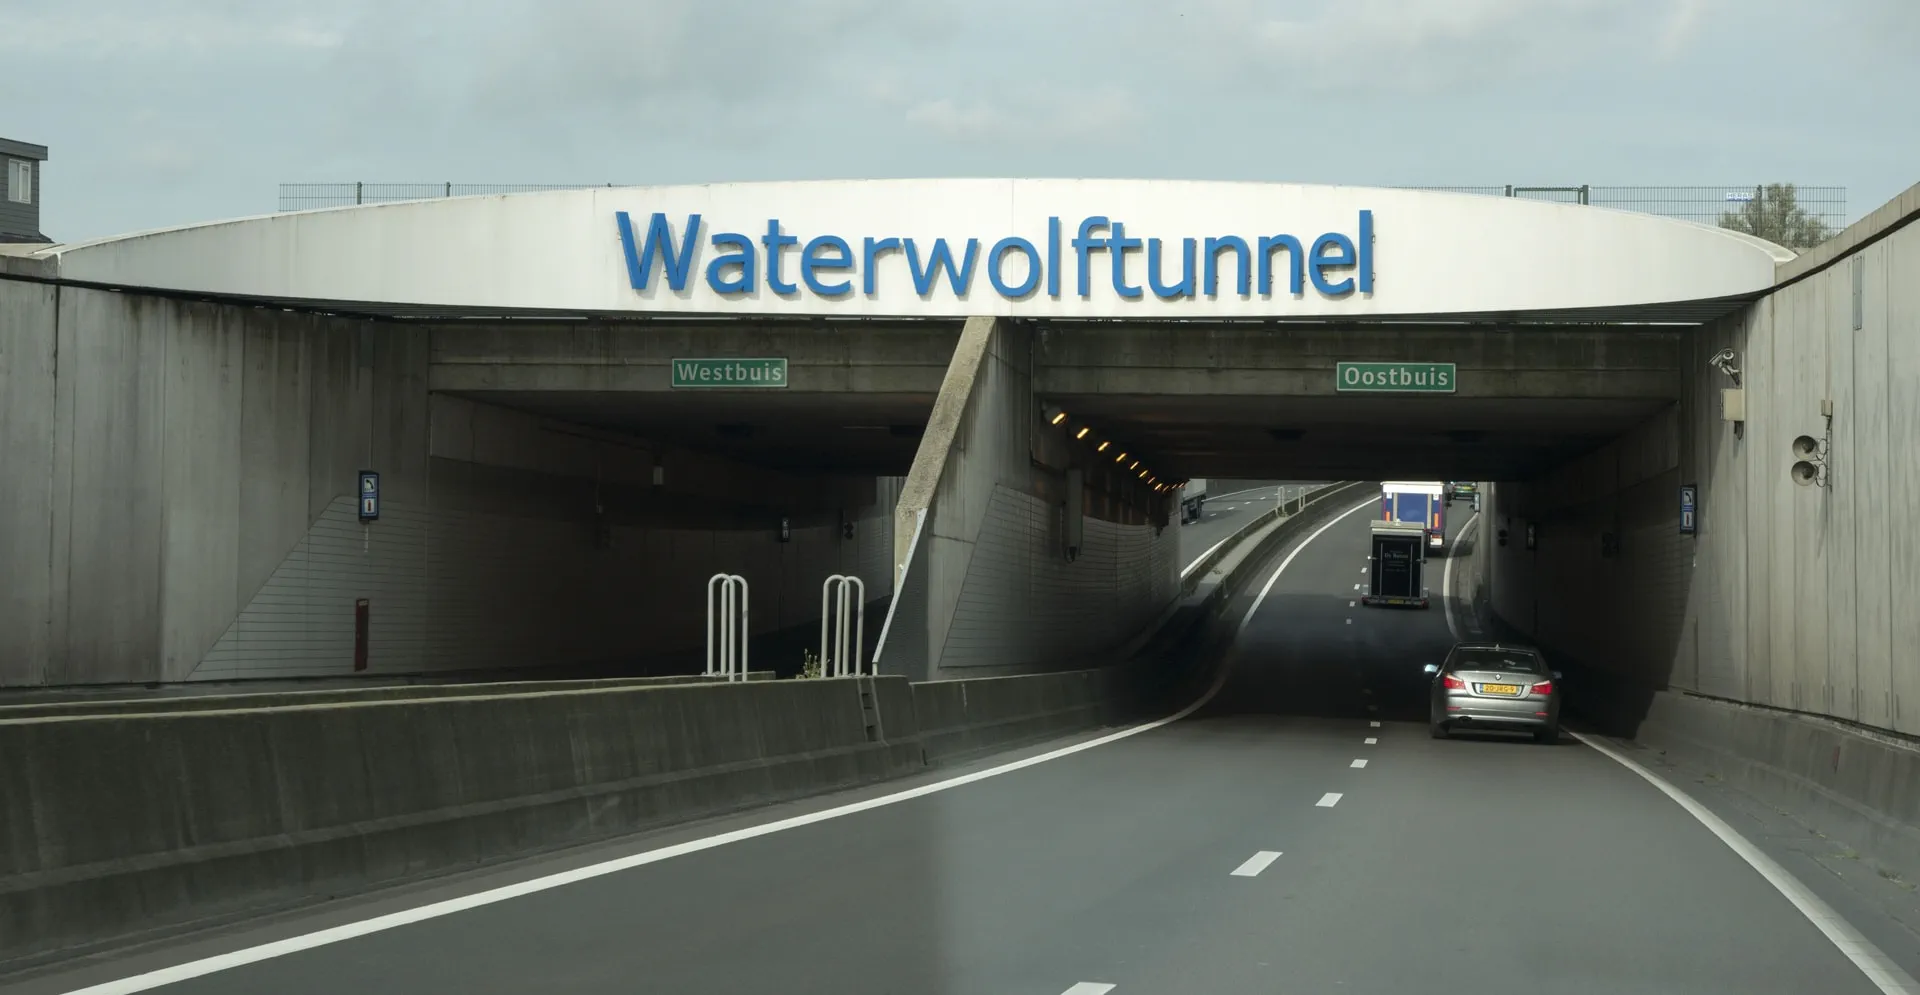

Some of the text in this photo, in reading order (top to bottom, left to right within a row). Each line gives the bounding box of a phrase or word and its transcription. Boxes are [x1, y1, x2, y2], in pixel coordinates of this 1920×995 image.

[615, 209, 1373, 297] Waterwolftunnel
[677, 362, 782, 381] Westbuis
[1344, 366, 1448, 386] Oostbuis
